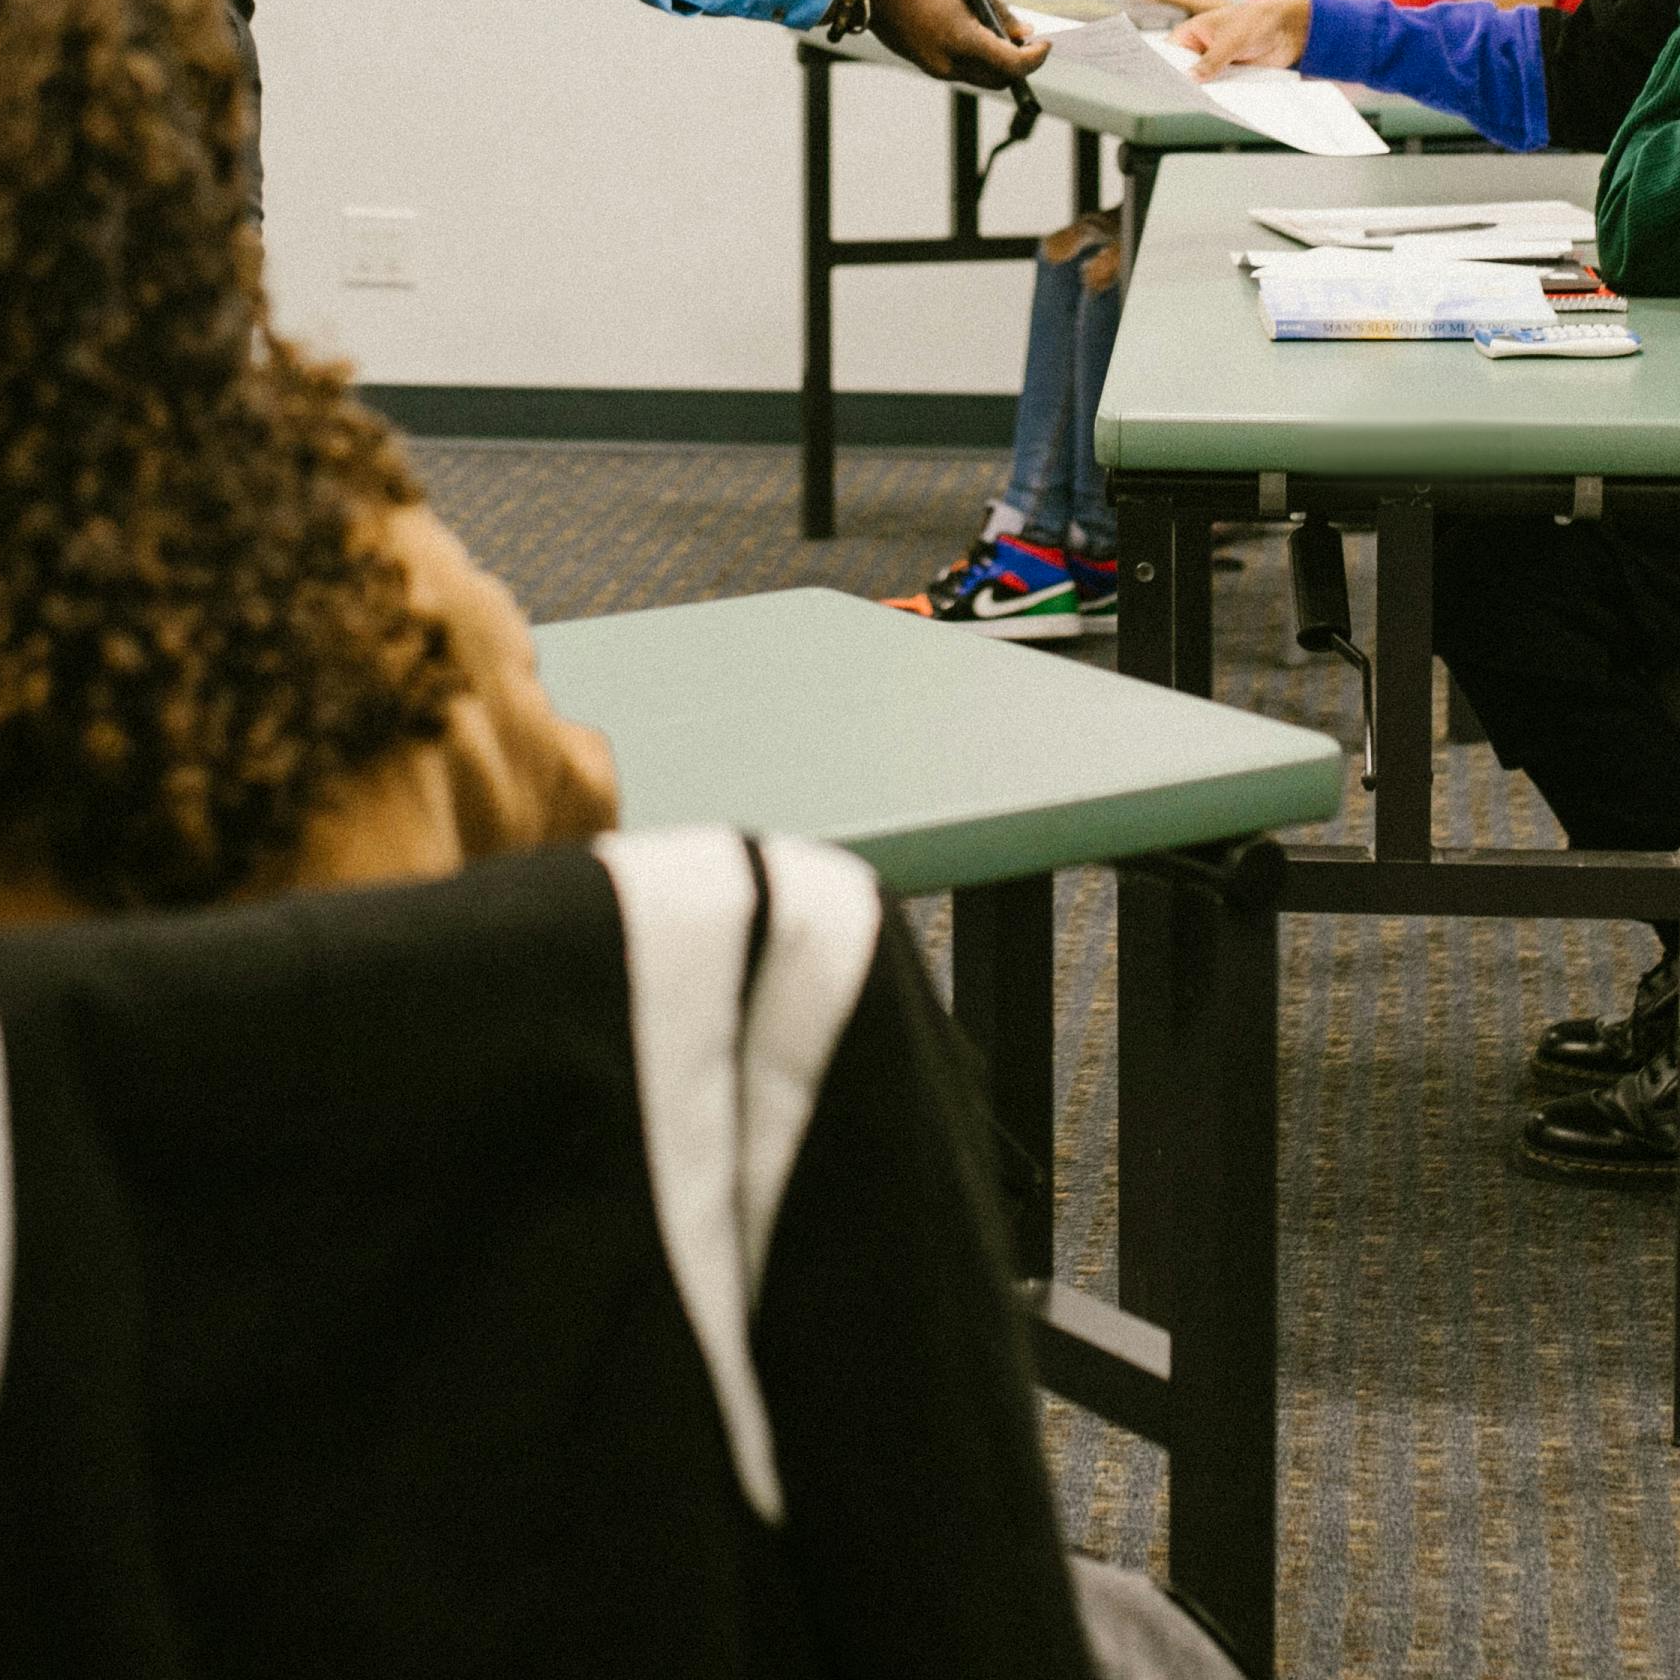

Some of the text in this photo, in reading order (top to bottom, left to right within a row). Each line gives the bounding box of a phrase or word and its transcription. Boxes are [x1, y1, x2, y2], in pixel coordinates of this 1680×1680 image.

[1321, 321, 1365, 333] MAN'S
[1367, 321, 1418, 333] SEARCH
[1421, 321, 1447, 333] FOR
